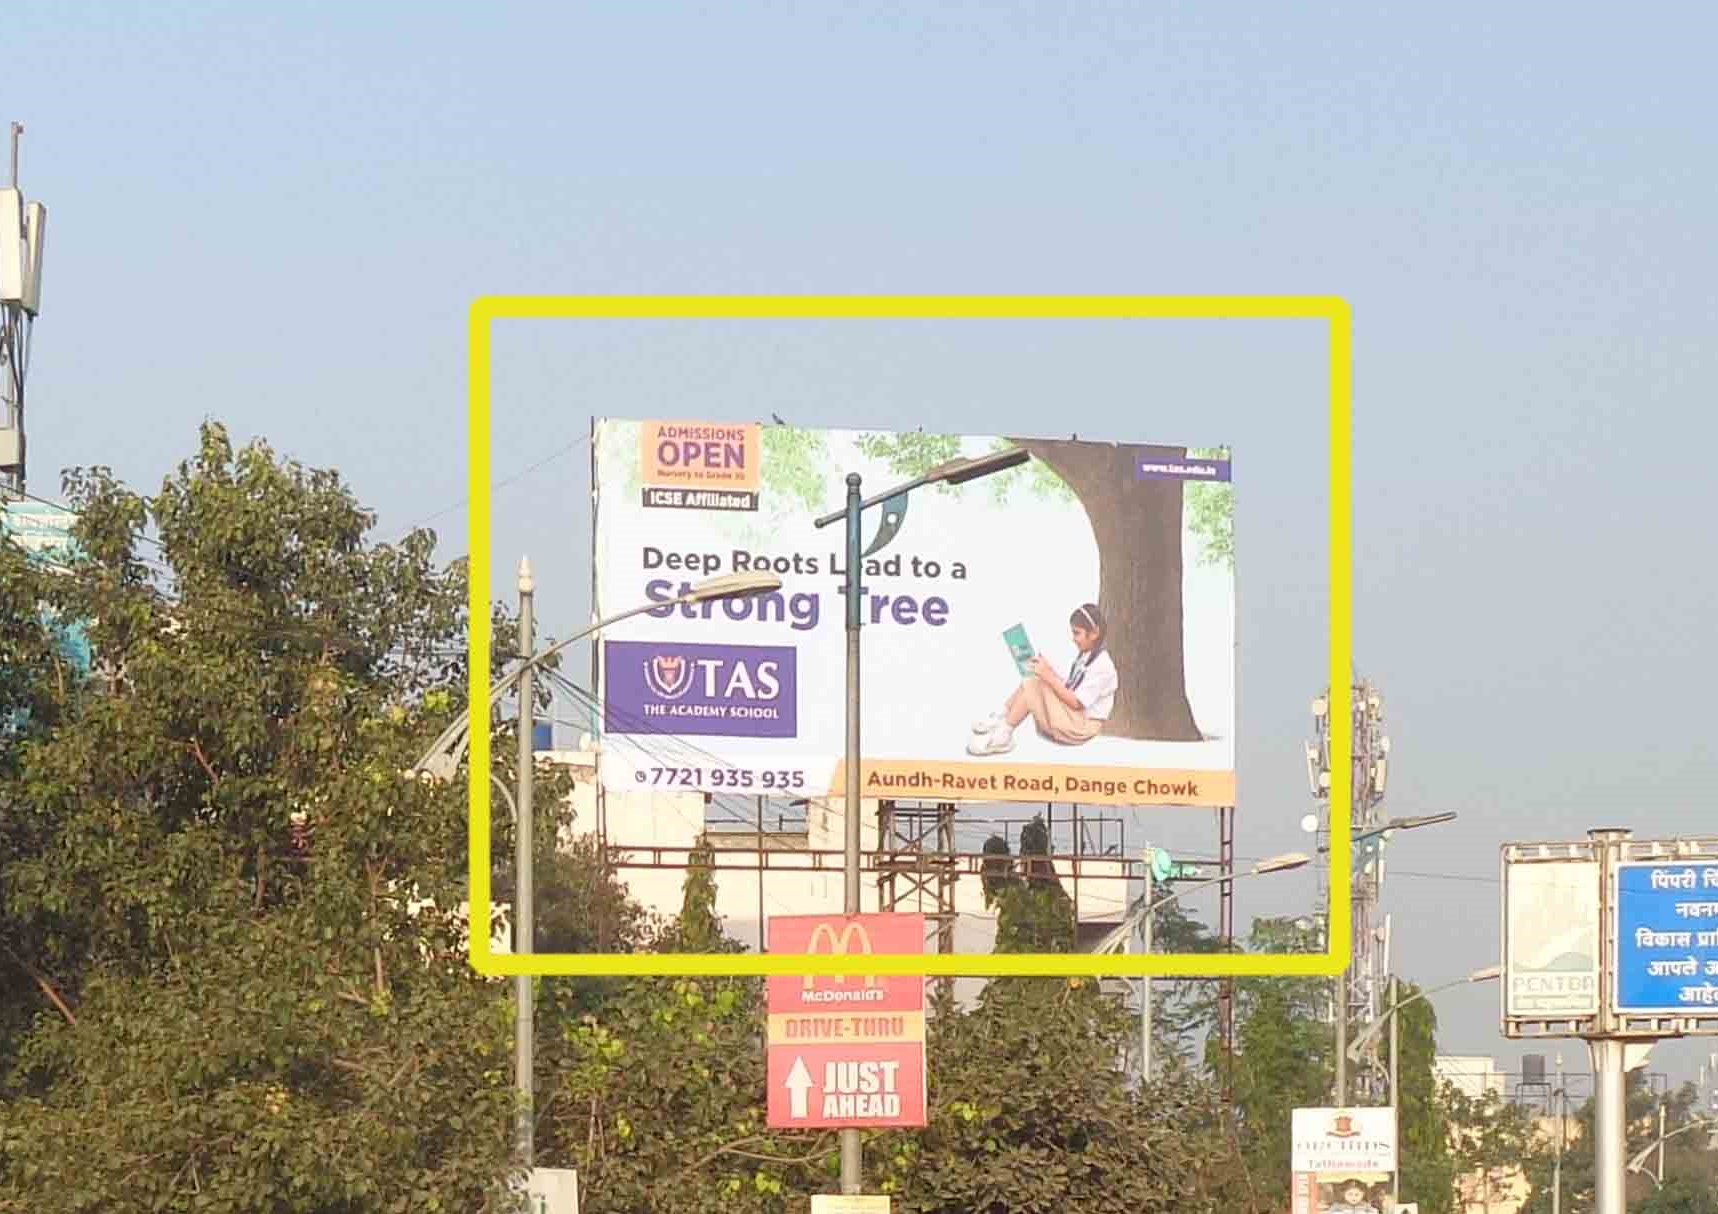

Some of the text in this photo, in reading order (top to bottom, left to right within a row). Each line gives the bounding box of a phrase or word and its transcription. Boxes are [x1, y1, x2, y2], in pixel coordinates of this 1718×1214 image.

[657, 426, 745, 440] ADMISSIONS
[658, 440, 745, 469] OPEN
[650, 491, 751, 509] ICSE Affiliated
[643, 547, 968, 579] Deep Roots Lad to a
[645, 579, 820, 631] Strong
[697, 659, 780, 700] TAS
[644, 704, 779, 719] THE ACADEMY SCHOOL
[650, 767, 805, 789] 7721 935 935
[867, 771, 1199, 797] Aundh-Ravet Road, Dange Chowk
[1651, 868, 1697, 889] पिंपरी
[1635, 927, 1692, 948] विकास
[1647, 956, 1699, 977] आपले
[801, 989, 886, 1003] McDonald's
[785, 1016, 905, 1038] DRIVE-THRU
[822, 1060, 900, 1094] JUST
[822, 1093, 901, 1119] AHEAD
